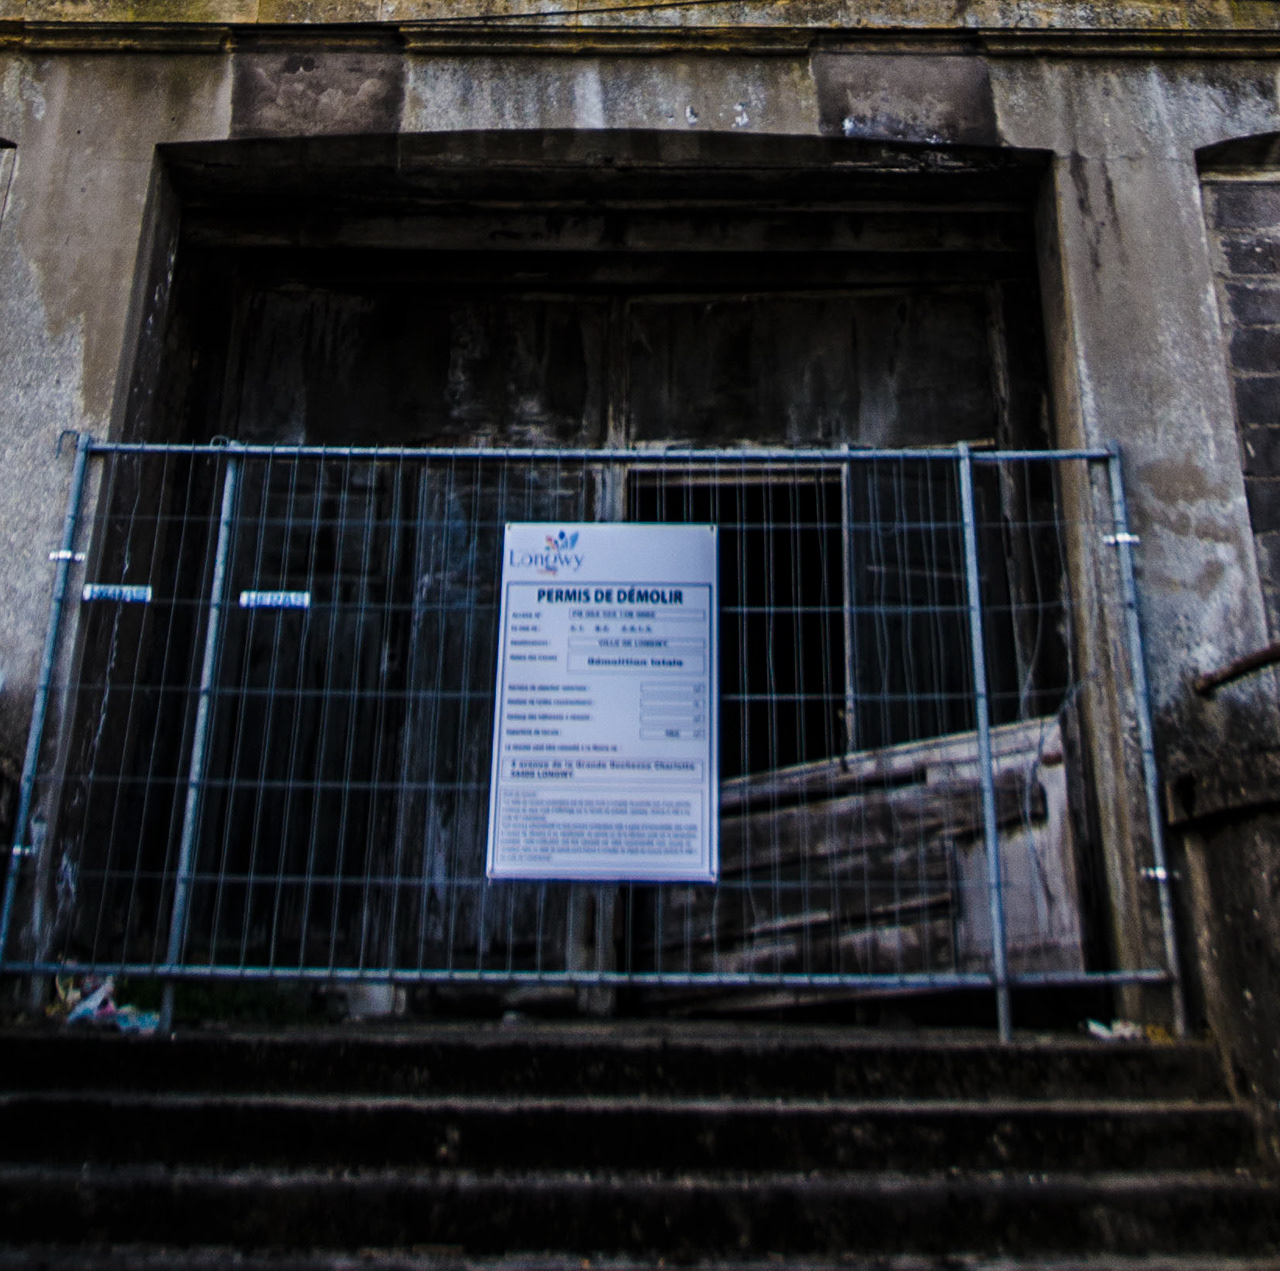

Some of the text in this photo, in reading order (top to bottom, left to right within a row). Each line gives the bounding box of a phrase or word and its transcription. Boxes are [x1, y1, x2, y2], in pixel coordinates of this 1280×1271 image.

[508, 548, 584, 573] Longwy
[537, 585, 684, 605] PERMIS DE DÉMOLIR
